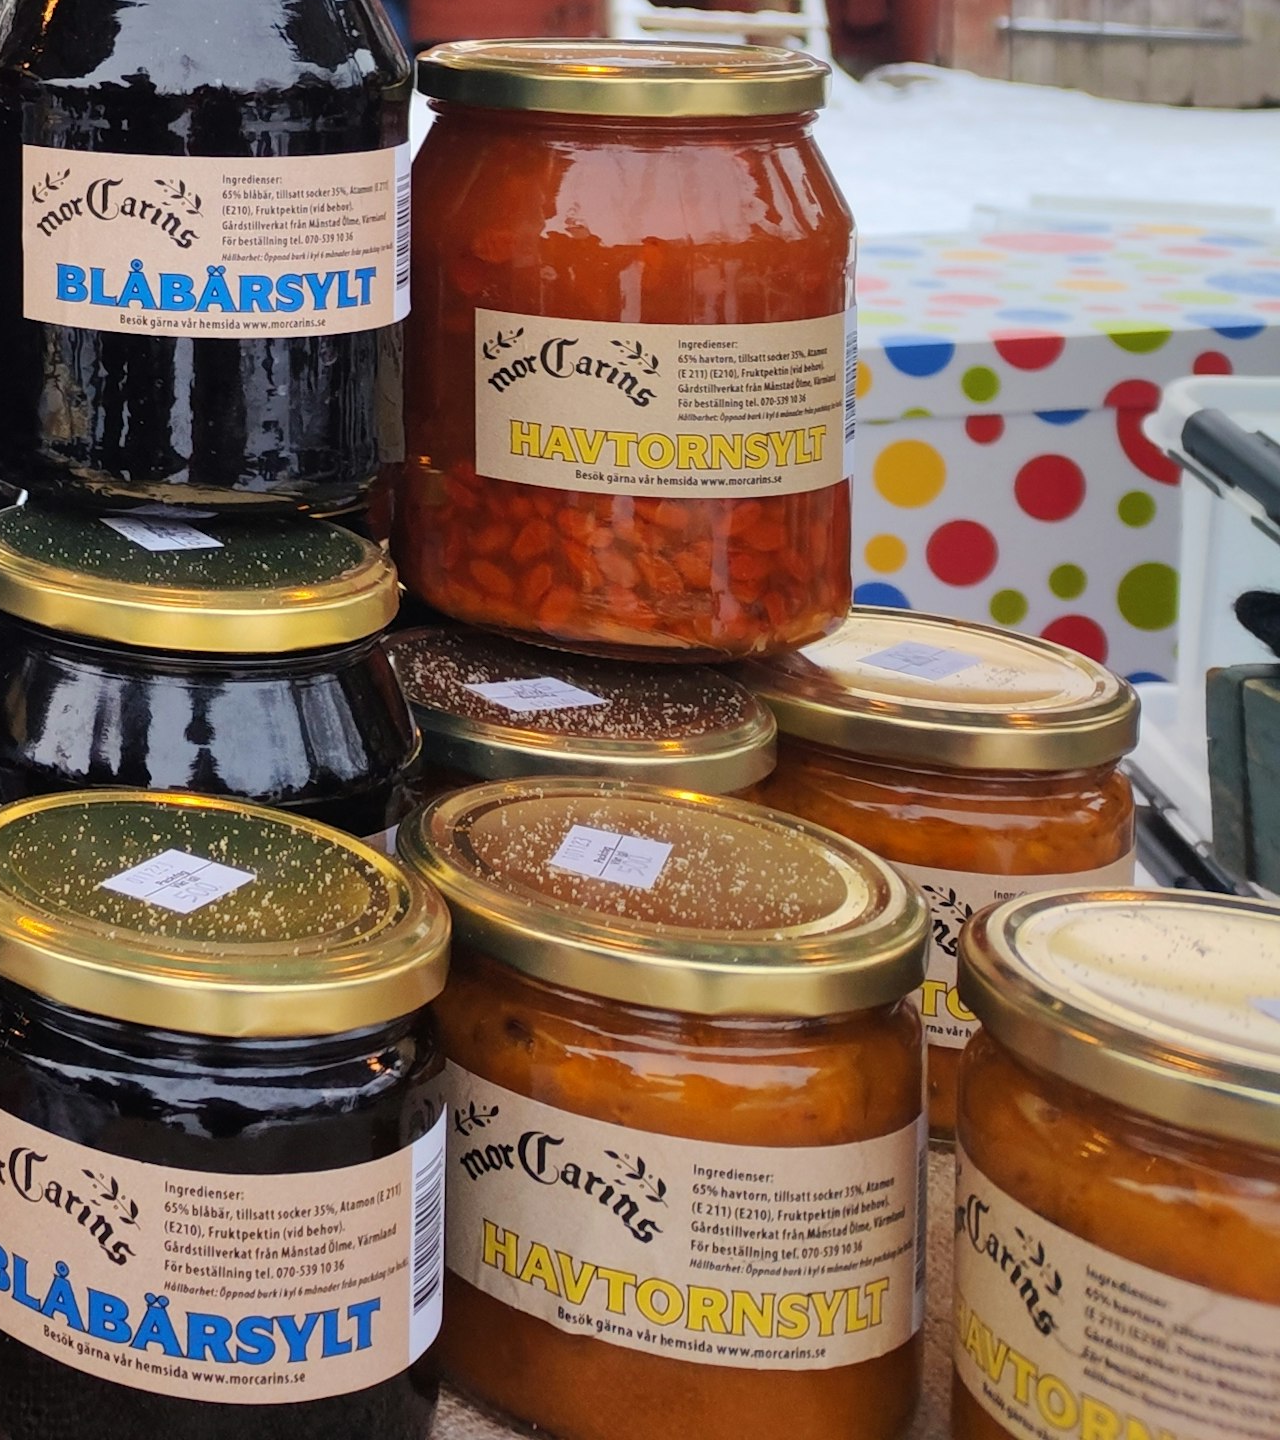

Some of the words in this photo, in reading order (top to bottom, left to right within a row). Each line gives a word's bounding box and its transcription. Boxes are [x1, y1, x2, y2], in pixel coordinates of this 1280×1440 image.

[37, 194, 83, 238] mor
[86, 177, 200, 249] Carins
[56, 259, 377, 313] BLÅBÄRSYLT
[243, 317, 326, 330] www.morcarins.se
[488, 352, 537, 393] mor
[540, 338, 658, 407] Carins
[509, 419, 827, 470] HAVTORNSYLT
[700, 474, 782, 486] www.morcarins.se
[8, 1146, 136, 1266] Carins
[165, 1182, 244, 1200] Ingredienser:
[165, 1202, 189, 1213] 65%
[192, 1205, 233, 1221] blåbär,
[236, 1209, 274, 1220] tillsatt
[277, 1208, 311, 1220] socker
[314, 1205, 338, 1216] 35%,
[340, 1197, 375, 1213] Atamon
[459, 1141, 514, 1182] mor
[517, 1131, 663, 1244] Carins
[164, 1240, 251, 1259] Gårdstillverkat
[256, 1246, 278, 1259] från
[281, 1240, 325, 1258] Månstad
[329, 1240, 355, 1253] Ölme,
[358, 1223, 397, 1246] Värmland
[165, 1221, 205, 1239] (E210),
[208, 1226, 280, 1242] Fruktpektin
[283, 1224, 304, 1239] (vid
[307, 1222, 345, 1236] behov).
[164, 1281, 218, 1296] Hållbarhet:
[220, 1286, 255, 1300] Öppnad
[257, 1289, 279, 1299] burk
[283, 1287, 296, 1300] kyl
[298, 1288, 303, 1296] 6
[304, 1282, 339, 1296] månader
[341, 1278, 357, 1289] från
[165, 1260, 182, 1273] För
[185, 1261, 252, 1282] beställning
[256, 1268, 273, 1280] tel.
[276, 1263, 317, 1278] 070-539
[321, 1263, 332, 1274] 10
[334, 1260, 344, 1272] 36
[482, 1218, 889, 1339] HAVTORNSYLT
[42, 1323, 75, 1351] Besök
[76, 1339, 111, 1363] gärna
[114, 1352, 133, 1370] vår
[135, 1358, 189, 1381] hemsida
[192, 1370, 306, 1385] www.morcarins.se
[557, 1306, 593, 1330] Besök
[596, 1317, 633, 1338] gärna
[637, 1328, 657, 1344] vår
[660, 1334, 713, 1355] hemsida
[716, 1343, 826, 1360] www.morcarins.se
[956, 1302, 1177, 1440] AVTOR
